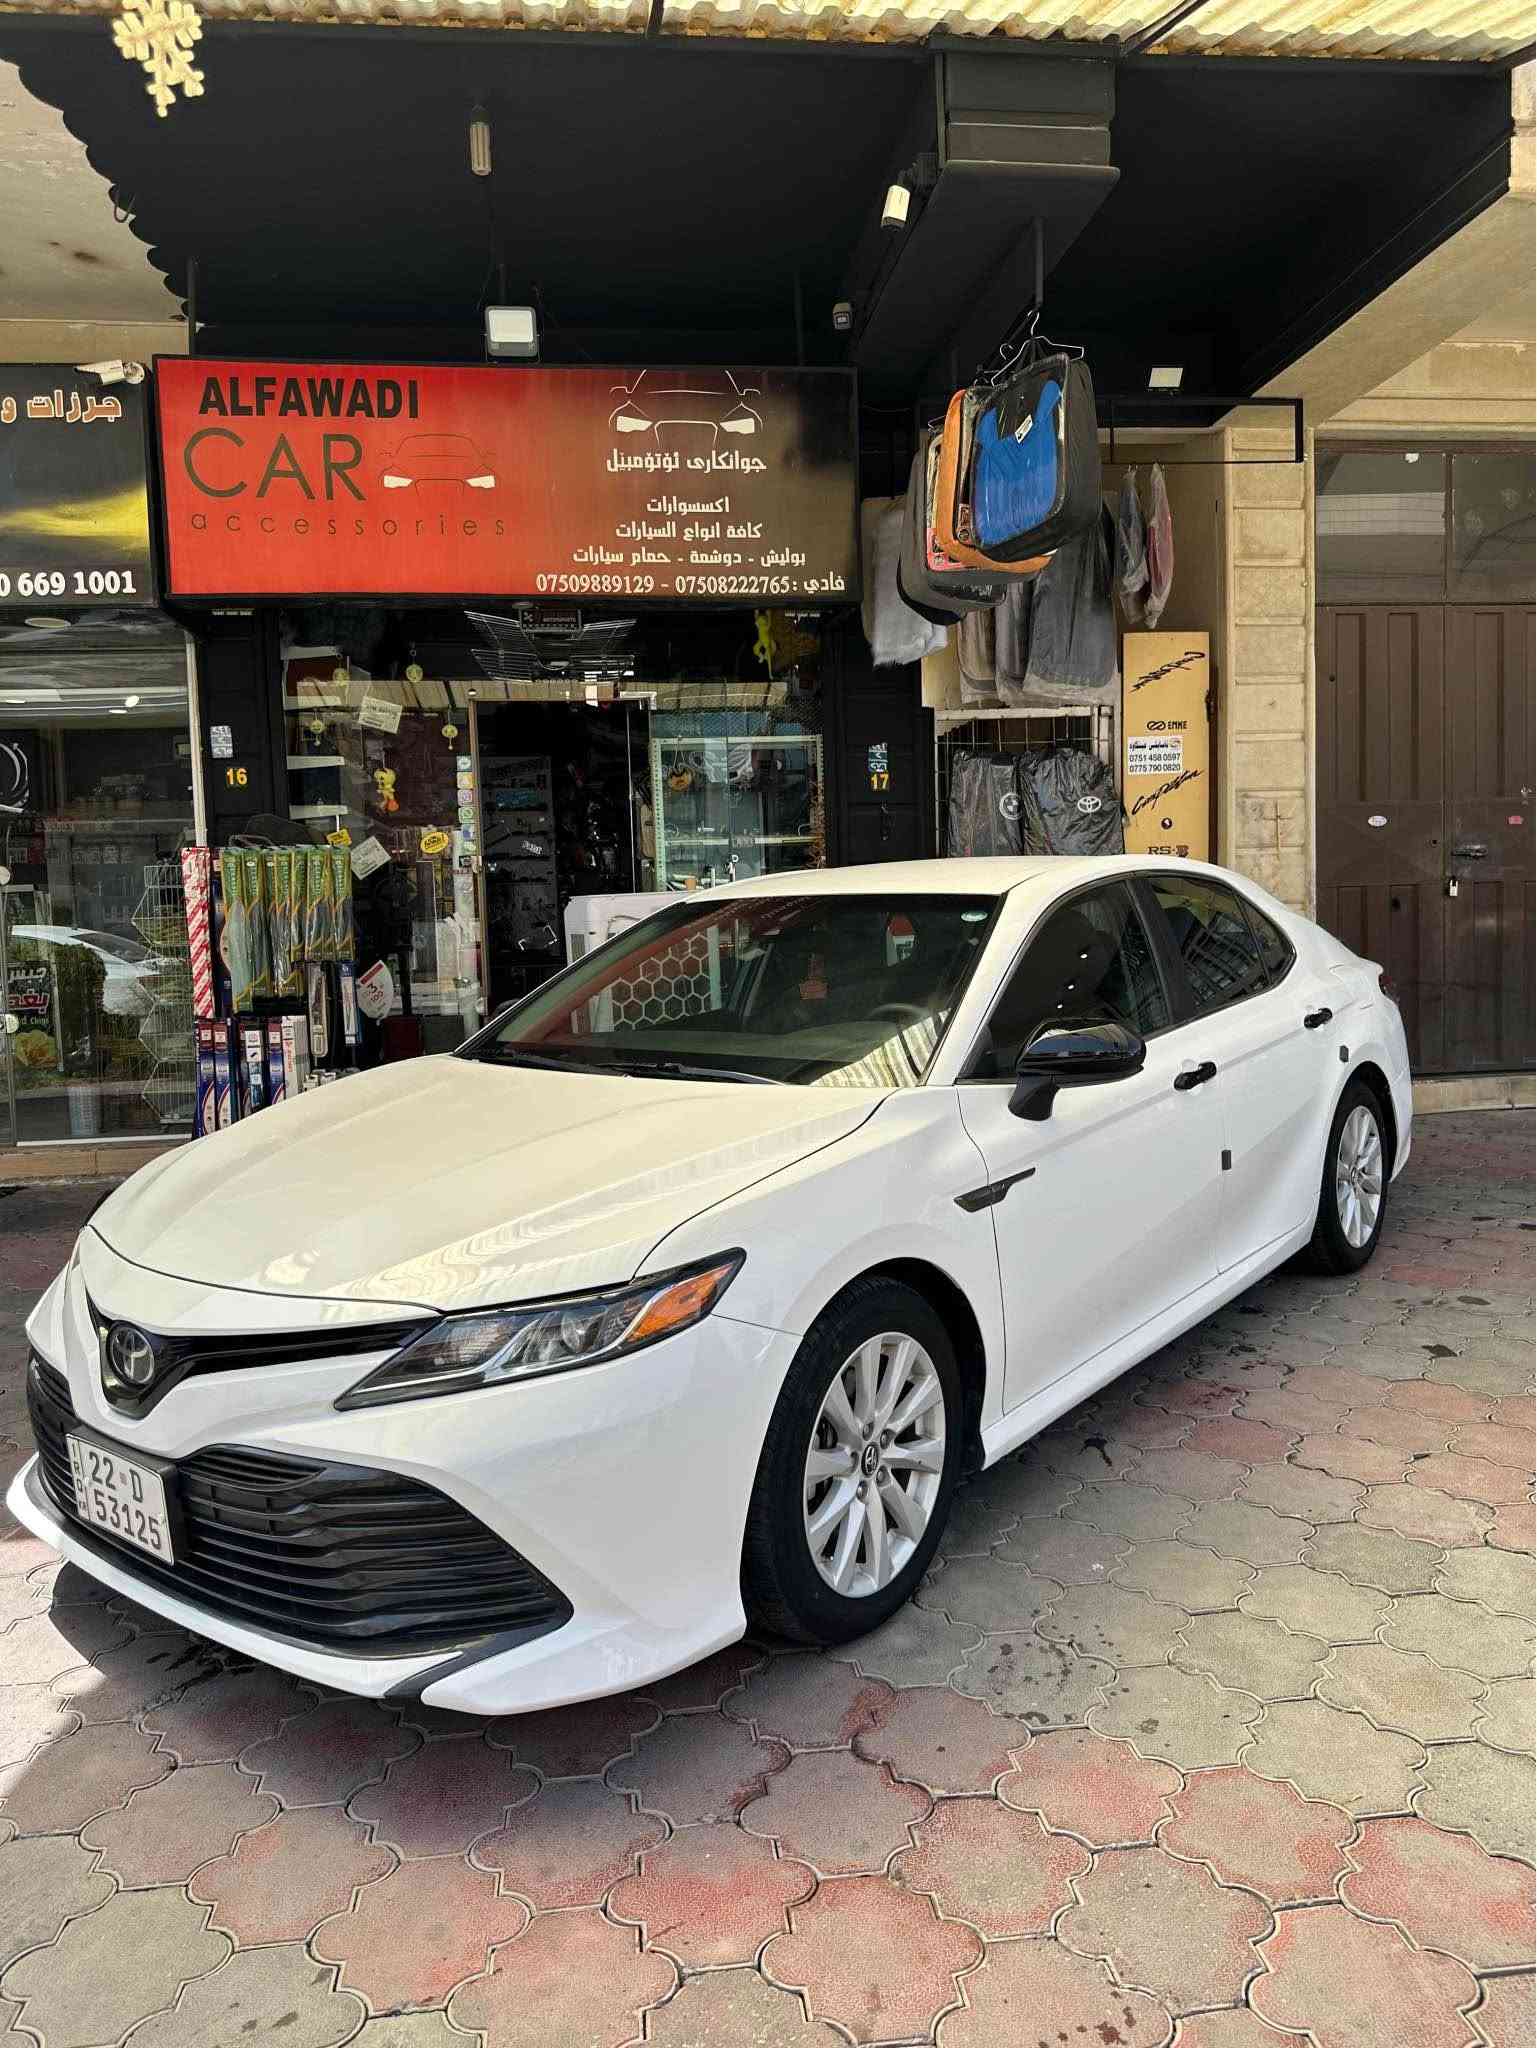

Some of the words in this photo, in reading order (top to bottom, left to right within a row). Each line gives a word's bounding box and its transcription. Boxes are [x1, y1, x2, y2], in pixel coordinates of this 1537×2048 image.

[27, 390, 122, 423] جرزات
[198, 377, 419, 418] ALFAWADI
[183, 427, 367, 501] CAR
[191, 512, 505, 536] accessories
[615, 521, 676, 539] السيارات
[683, 522, 720, 541] انواع
[726, 523, 762, 539] كافة
[573, 546, 624, 564] سيارات
[630, 548, 671, 566] حمام
[690, 547, 742, 565] دوشمة
[760, 548, 806, 567] بوليش
[17, 571, 66, 596] 669
[73, 570, 137, 595] 1001
[536, 574, 655, 593] 07509889129
[675, 575, 790, 594] 07508222765
[226, 767, 248, 785] 16
[871, 773, 889, 790] 17
[88, 1451, 116, 1491] 22
[129, 1468, 144, 1503] D
[94, 1488, 162, 1551] 53125
